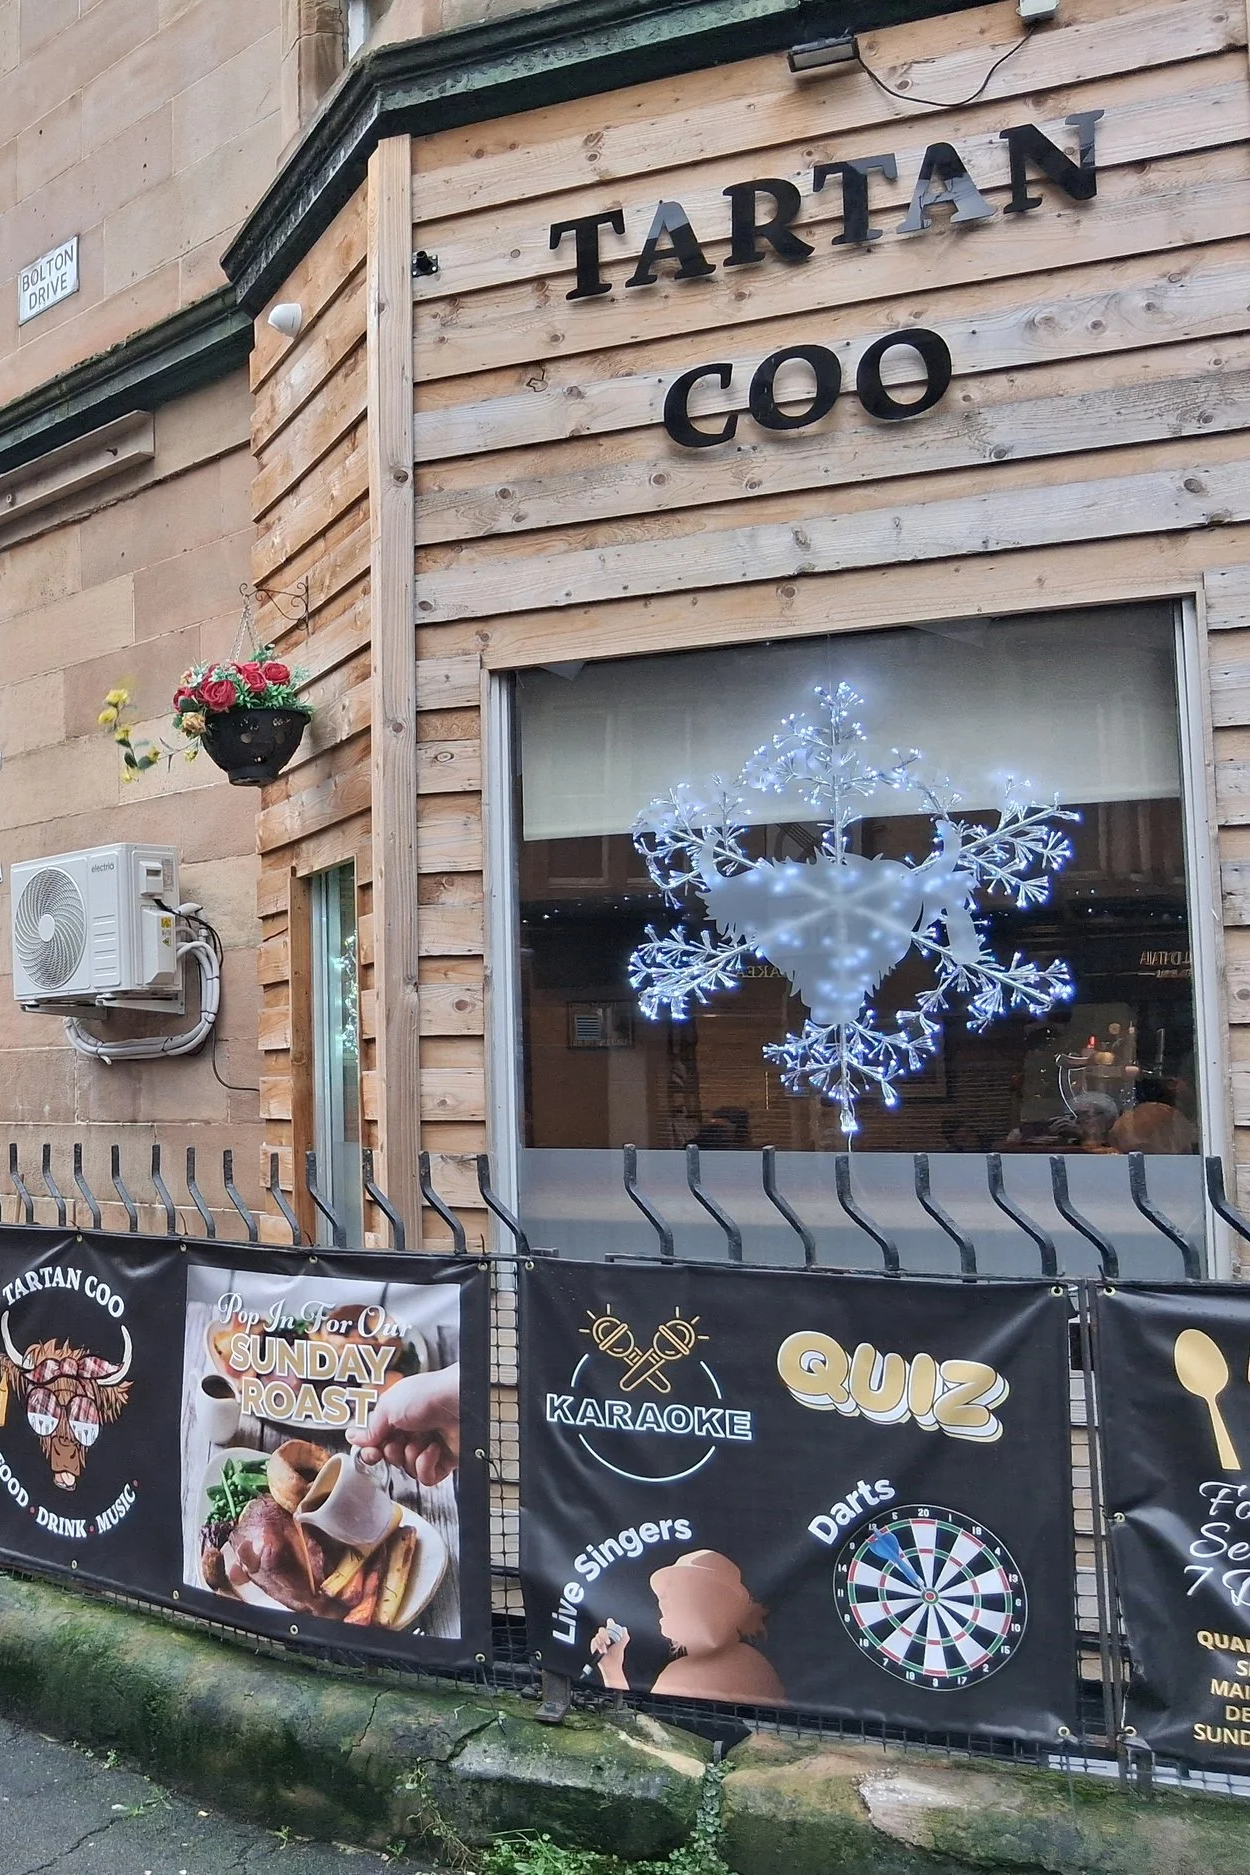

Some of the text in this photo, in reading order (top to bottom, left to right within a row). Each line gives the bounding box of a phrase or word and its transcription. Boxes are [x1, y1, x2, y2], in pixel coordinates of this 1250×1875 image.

[549, 109, 1105, 301] TARTAN
[22, 244, 74, 293] BOLTON
[28, 271, 68, 311] DRIVE
[662, 328, 952, 448] COO
[2, 1265, 125, 1318] TARTAN COO
[217, 1292, 413, 1338] Pop In For Our
[229, 1332, 397, 1385] SUNDAY
[241, 1376, 378, 1428] ROAST
[777, 1330, 1010, 1443] QUIZ
[546, 1393, 753, 1441] KARAOKE
[35, 1505, 87, 1538] DRINK
[95, 1483, 136, 1534] MUSIC
[807, 1479, 896, 1545] Darts
[917, 1508, 930, 1518] 20
[551, 1518, 693, 1645] Live Singers
[837, 1564, 848, 1572] 14
[1008, 1574, 1018, 1583] 13
[1184, 1565, 1214, 1596] 7
[1000, 1645, 1011, 1655] 15
[957, 1676, 968, 1685] 17
